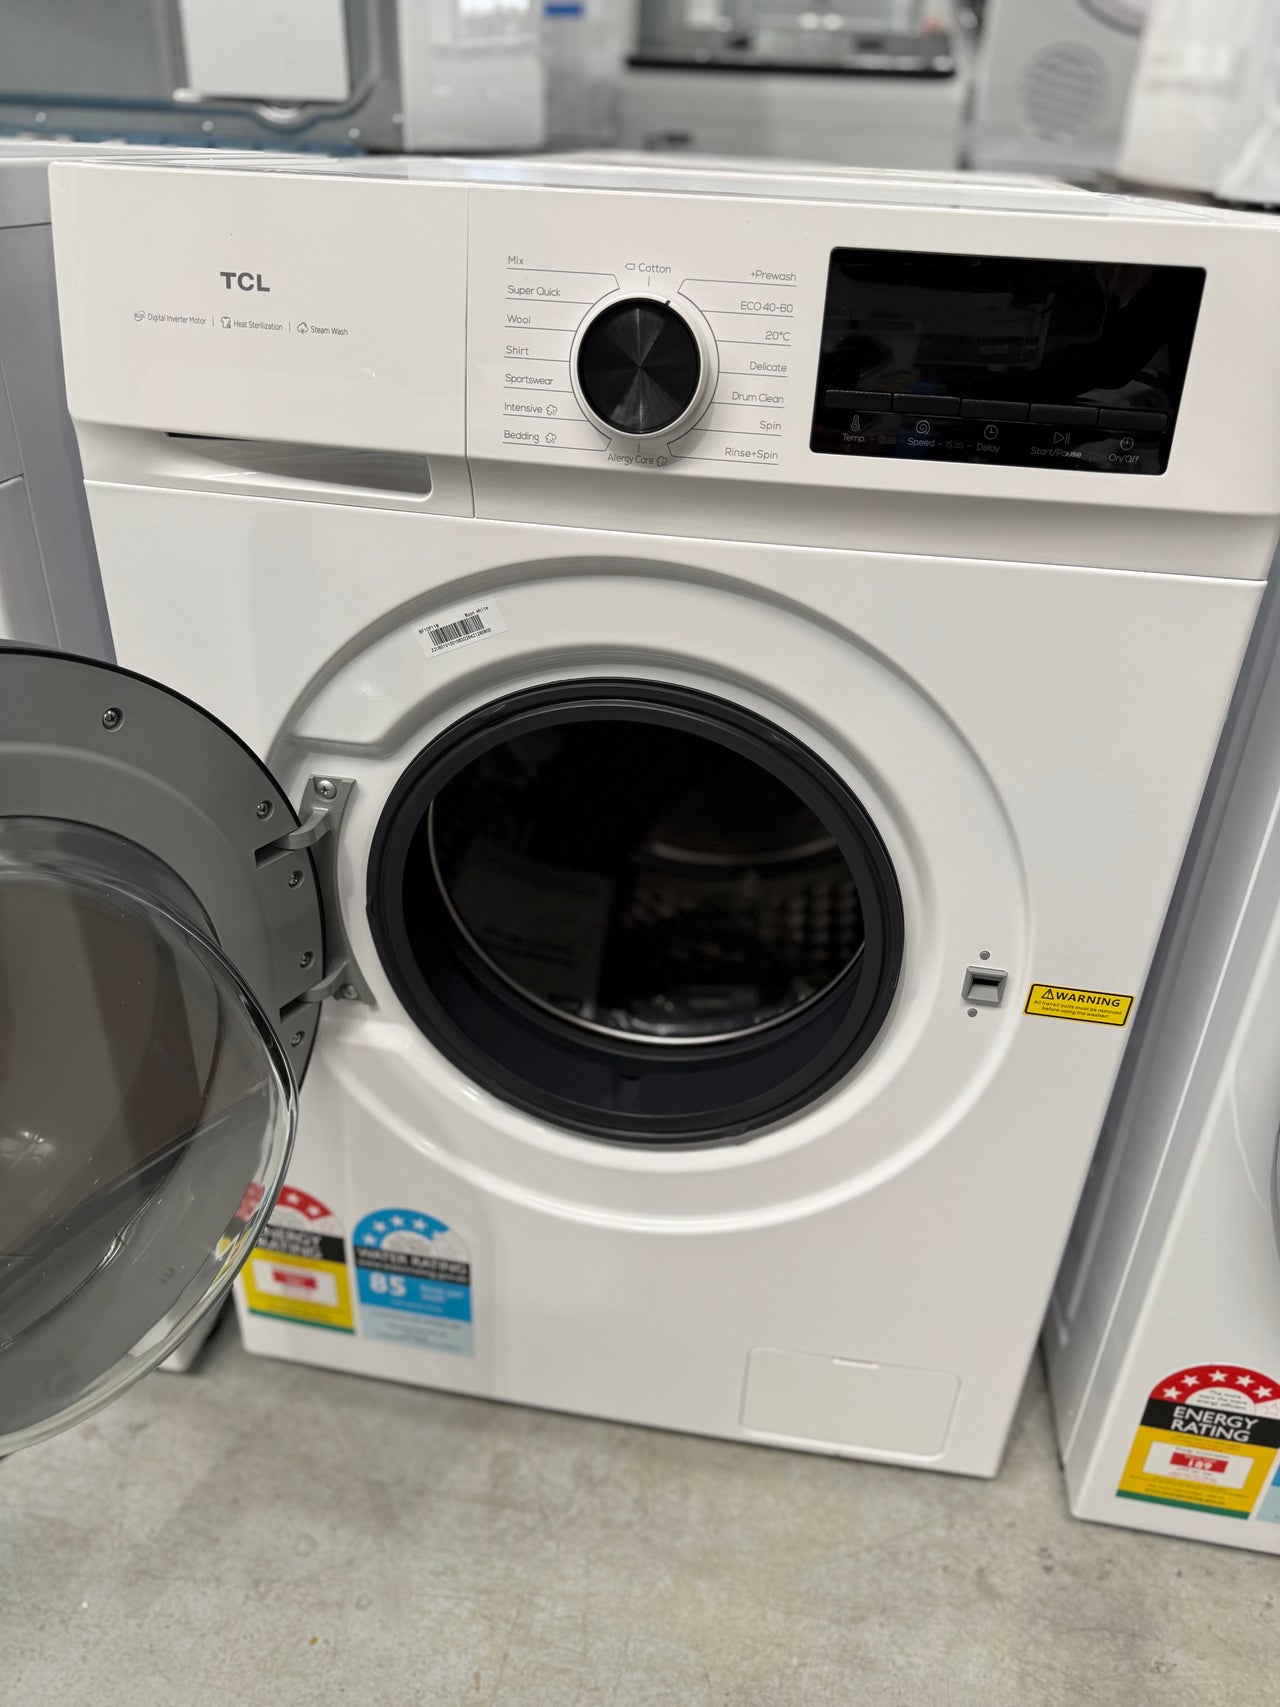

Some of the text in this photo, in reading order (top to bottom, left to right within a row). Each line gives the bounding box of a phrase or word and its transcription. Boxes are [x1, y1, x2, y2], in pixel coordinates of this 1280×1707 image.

[507, 255, 524, 265] Mix
[638, 262, 672, 274] Cotton
[219, 271, 271, 292] TCL
[751, 269, 797, 281] +Prewash
[507, 284, 561, 297] Super Quick
[740, 300, 793, 313] ECO 40-60
[147, 312, 166, 322] Digital
[166, 314, 188, 324] Inverter
[189, 315, 206, 325] Motor
[233, 319, 283, 331] Heat Sterilization
[506, 314, 531, 325] Wool
[310, 325, 348, 336] Steam Wash
[765, 330, 791, 341] 20°C
[505, 345, 529, 356] Shirt
[749, 361, 788, 372] Delicate
[505, 373, 554, 386] Sportswear
[731, 391, 785, 404] Drum Clean
[504, 402, 543, 414] Intensive
[759, 420, 782, 431] Spin
[504, 429, 540, 444] Bedding
[724, 446, 779, 460] Rinse+Spin
[907, 436, 935, 448] Speed
[976, 442, 1000, 454] Delay
[1030, 446, 1082, 459] Start/Pause
[1108, 452, 1140, 464] On/Off
[607, 453, 654, 465] Allergy Care
[1056, 991, 1121, 1008] WARNING
[369, 1272, 407, 1298] 85
[1173, 1405, 1259, 1431] ENERGY
[1170, 1418, 1251, 1443] RATING
